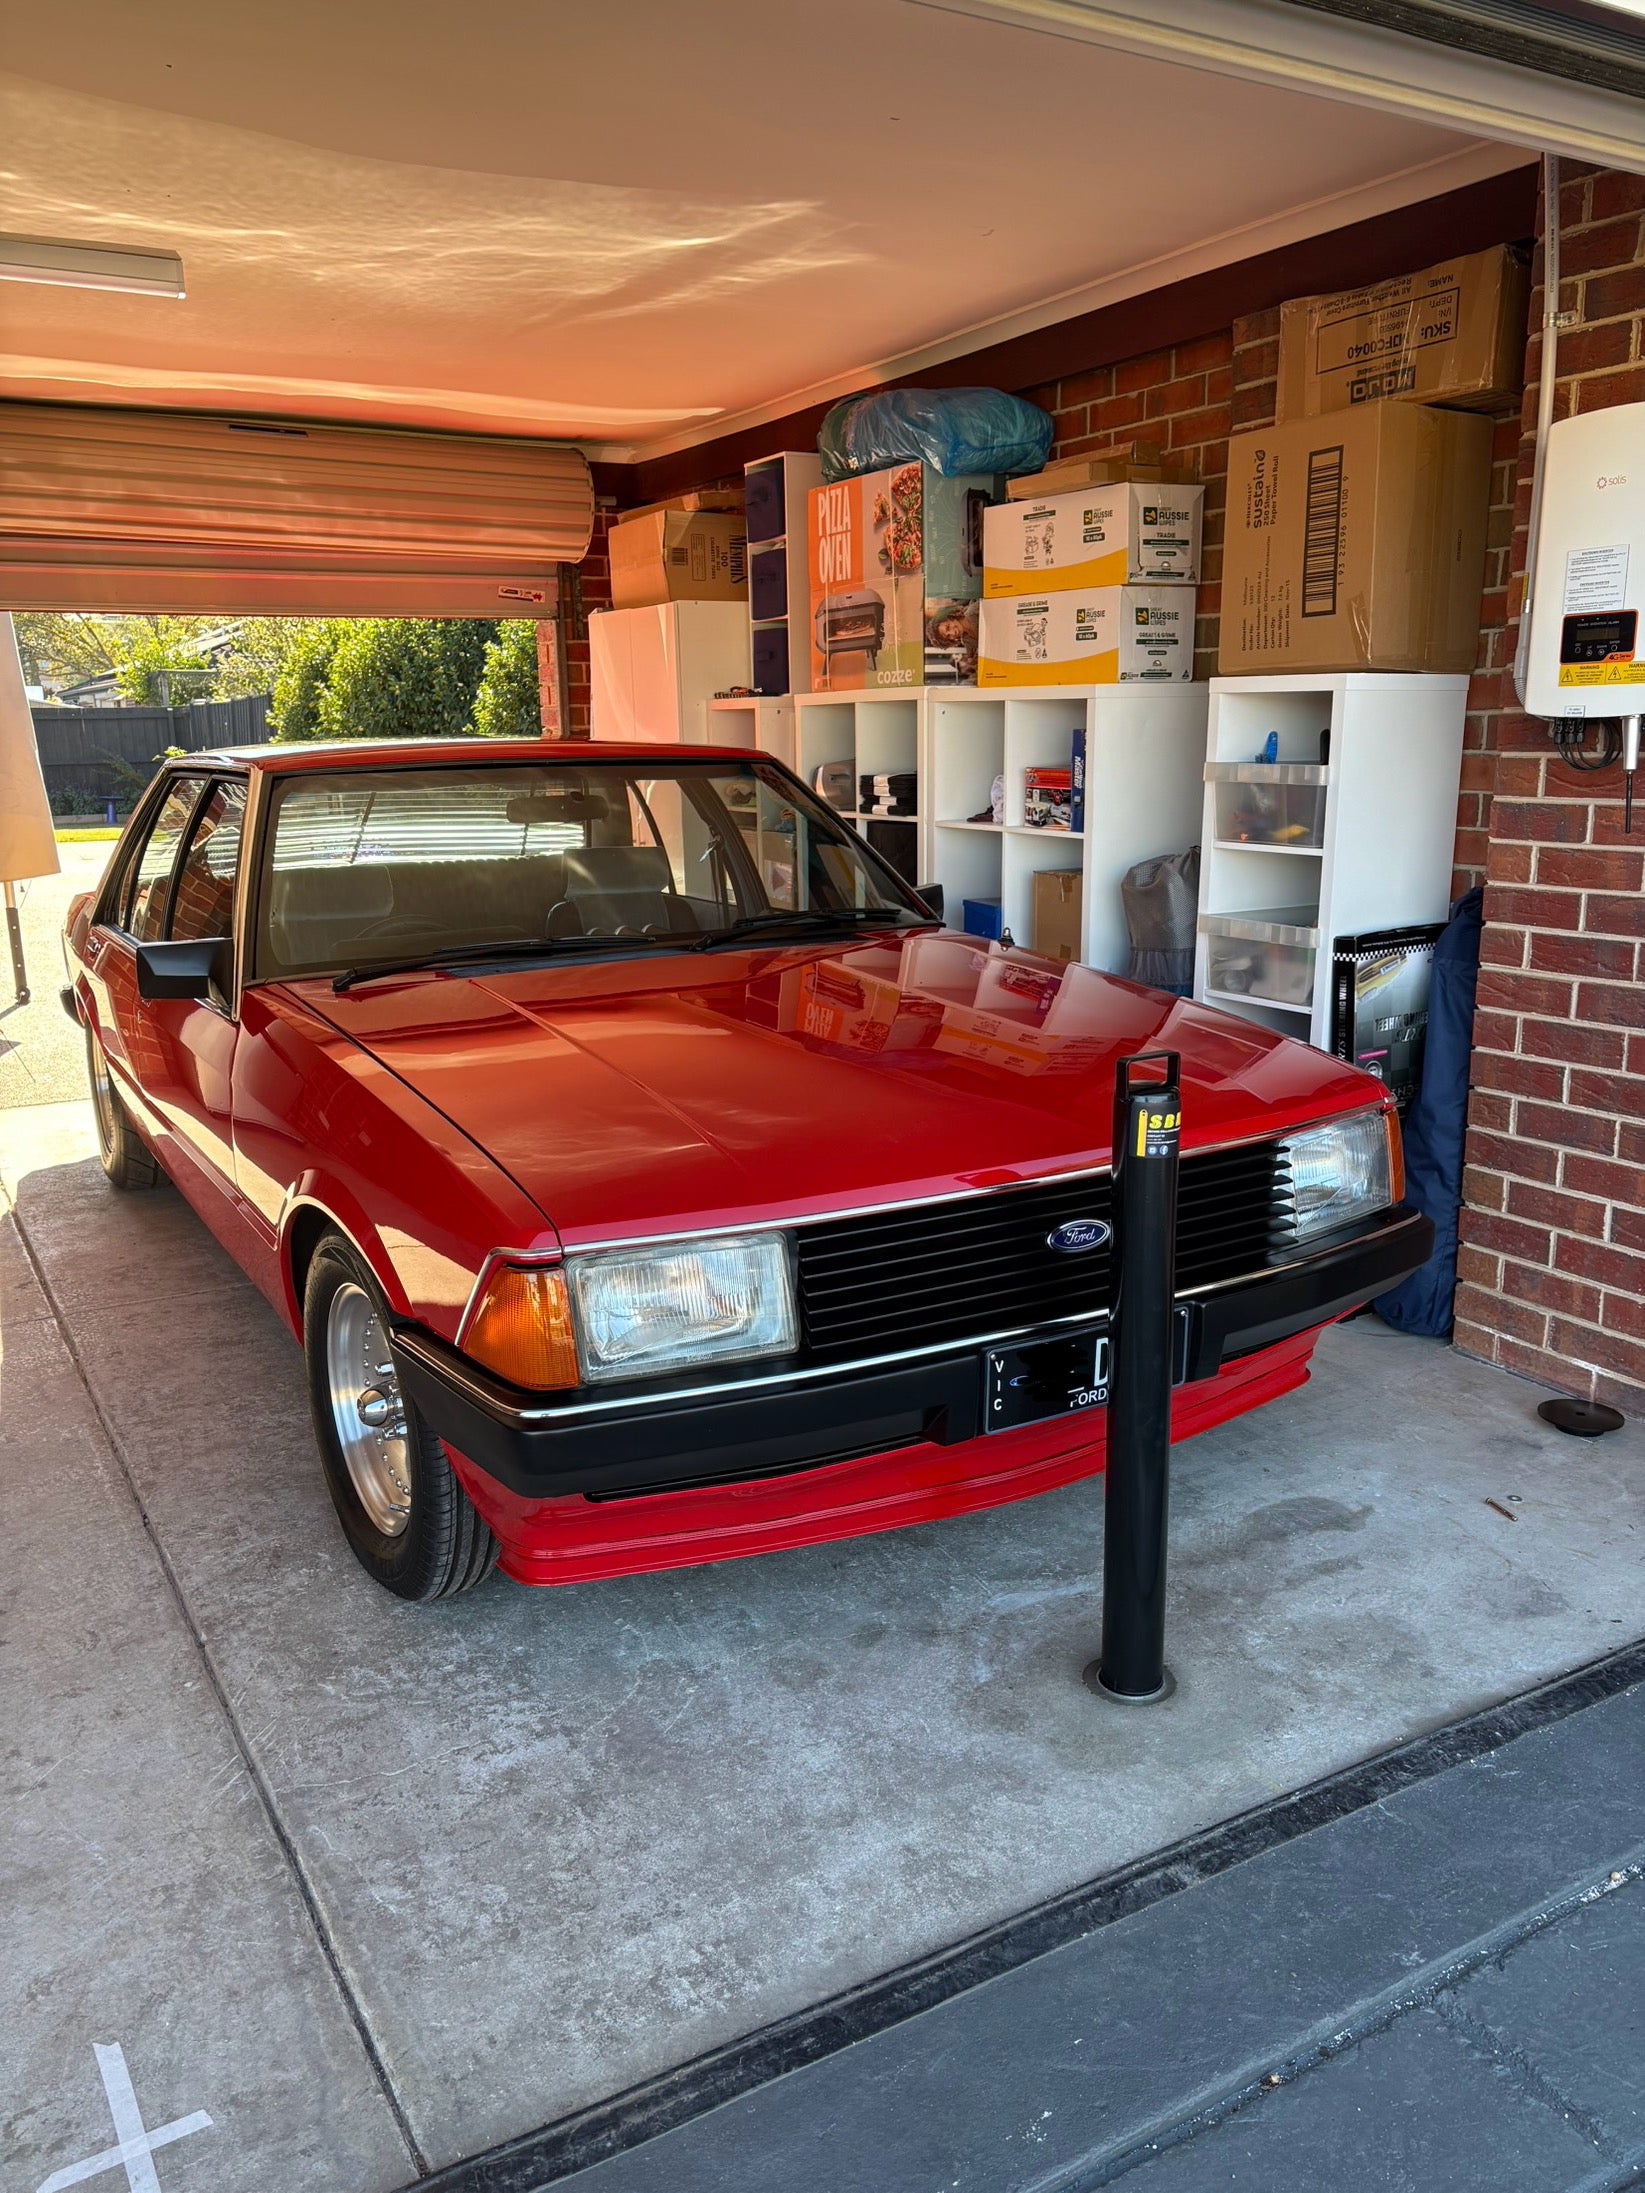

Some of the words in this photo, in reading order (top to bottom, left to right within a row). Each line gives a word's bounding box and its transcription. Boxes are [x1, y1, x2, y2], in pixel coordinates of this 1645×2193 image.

[1421, 320, 1452, 339] SKU:
[1608, 474, 1627, 485] solis
[1254, 462, 1264, 528] sustain
[818, 486, 851, 536] PIZZA
[1094, 510, 1113, 518] AUSSIE
[1159, 512, 1189, 520] AUSSIE
[728, 535, 748, 583] MEMPHIS
[818, 532, 852, 584] OVEN
[1150, 612, 1179, 620] AUSSIE
[877, 668, 913, 685] cozze
[1064, 1227, 1096, 1244] Ford
